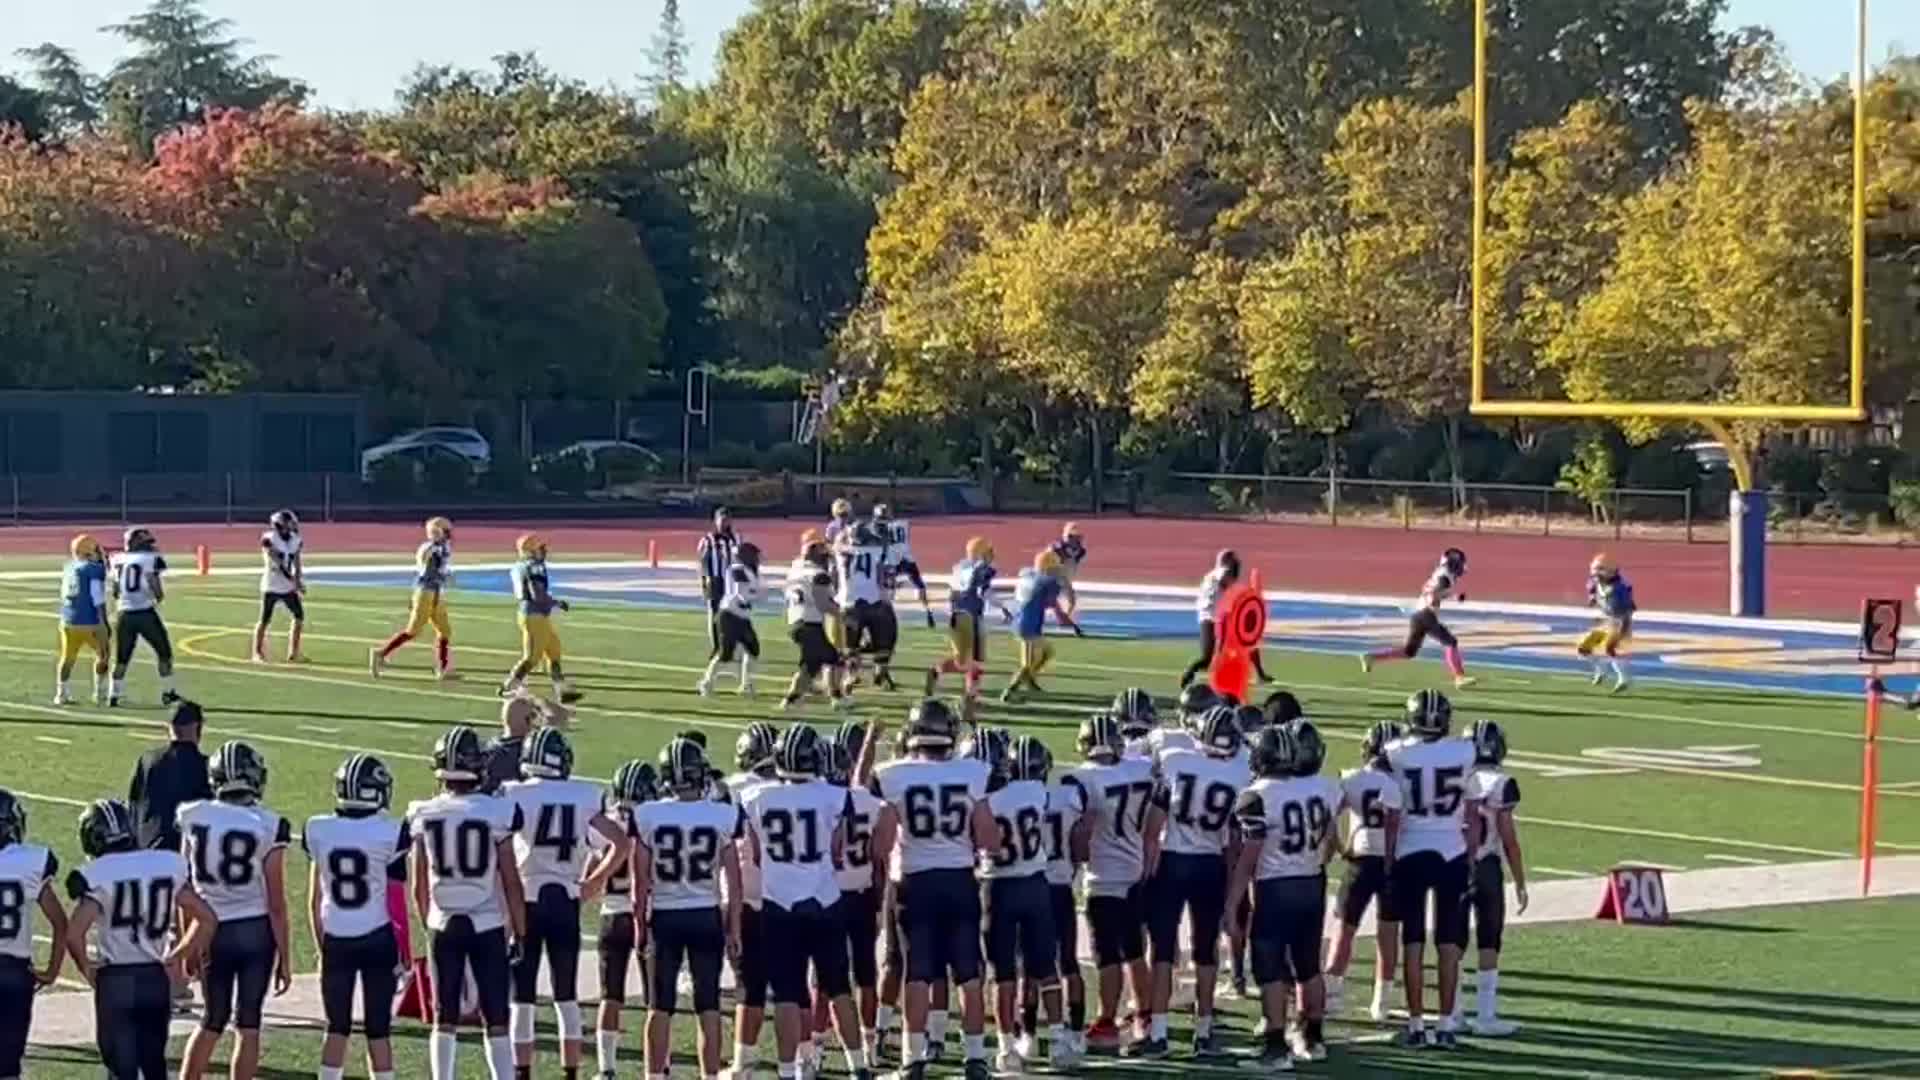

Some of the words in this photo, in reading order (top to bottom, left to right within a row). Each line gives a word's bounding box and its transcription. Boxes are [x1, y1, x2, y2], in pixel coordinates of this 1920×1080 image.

[1872, 605, 1898, 653] 2
[904, 784, 969, 839] 65
[1105, 781, 1153, 836] 77
[1176, 773, 1237, 831] 19
[1405, 767, 1464, 816] 15
[191, 824, 257, 885] 18
[424, 818, 491, 879] 10
[534, 803, 578, 862] 4
[654, 826, 719, 882] 32
[761, 808, 823, 864] 31
[1282, 797, 1331, 855] 99
[329, 848, 370, 909] 8
[1618, 872, 1664, 919] 20
[110, 877, 175, 944] 40
